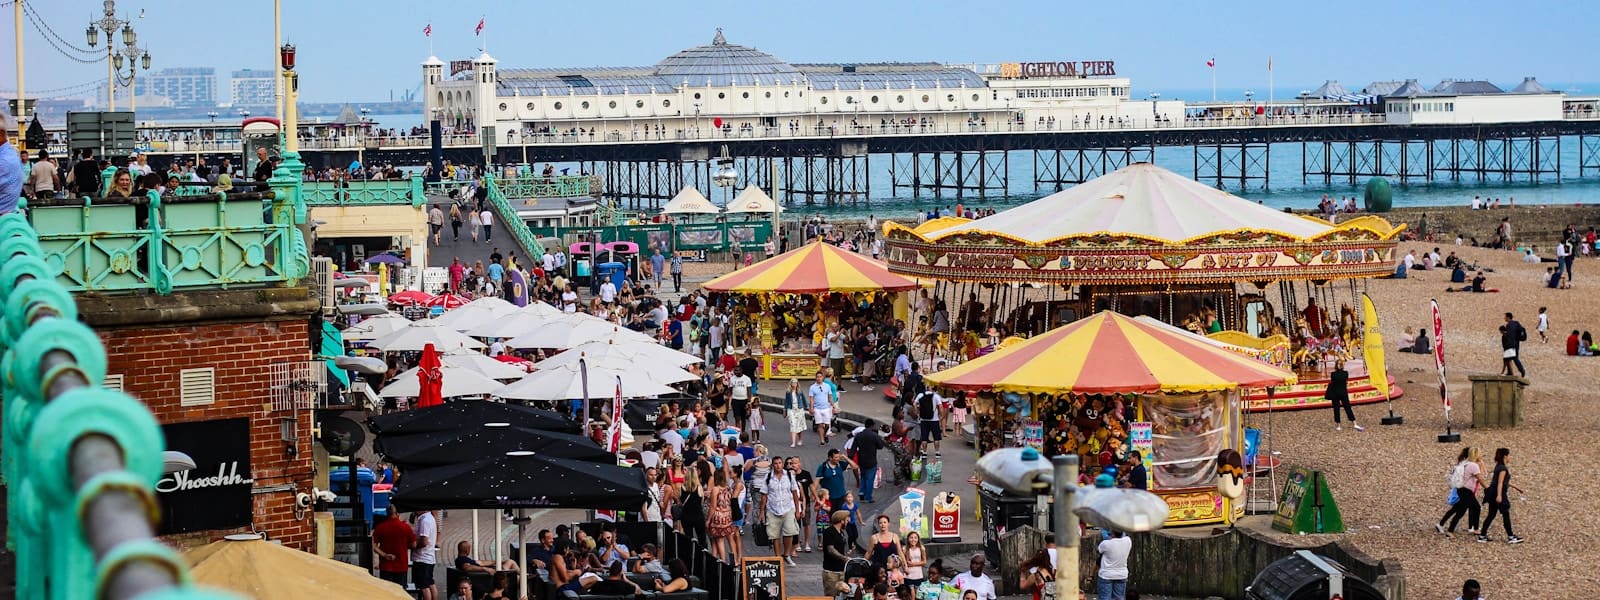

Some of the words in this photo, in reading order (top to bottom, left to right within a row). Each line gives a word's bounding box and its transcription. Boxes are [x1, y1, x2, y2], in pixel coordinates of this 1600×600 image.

[1001, 61, 1077, 77] BRIGHTON
[1081, 60, 1116, 76] PIER
[1073, 255, 1151, 269] DELIGHT
[1202, 254, 1216, 269] A
[1218, 253, 1252, 267] SET
[1256, 252, 1278, 266] OF
[750, 569, 777, 578] PIMM'S
